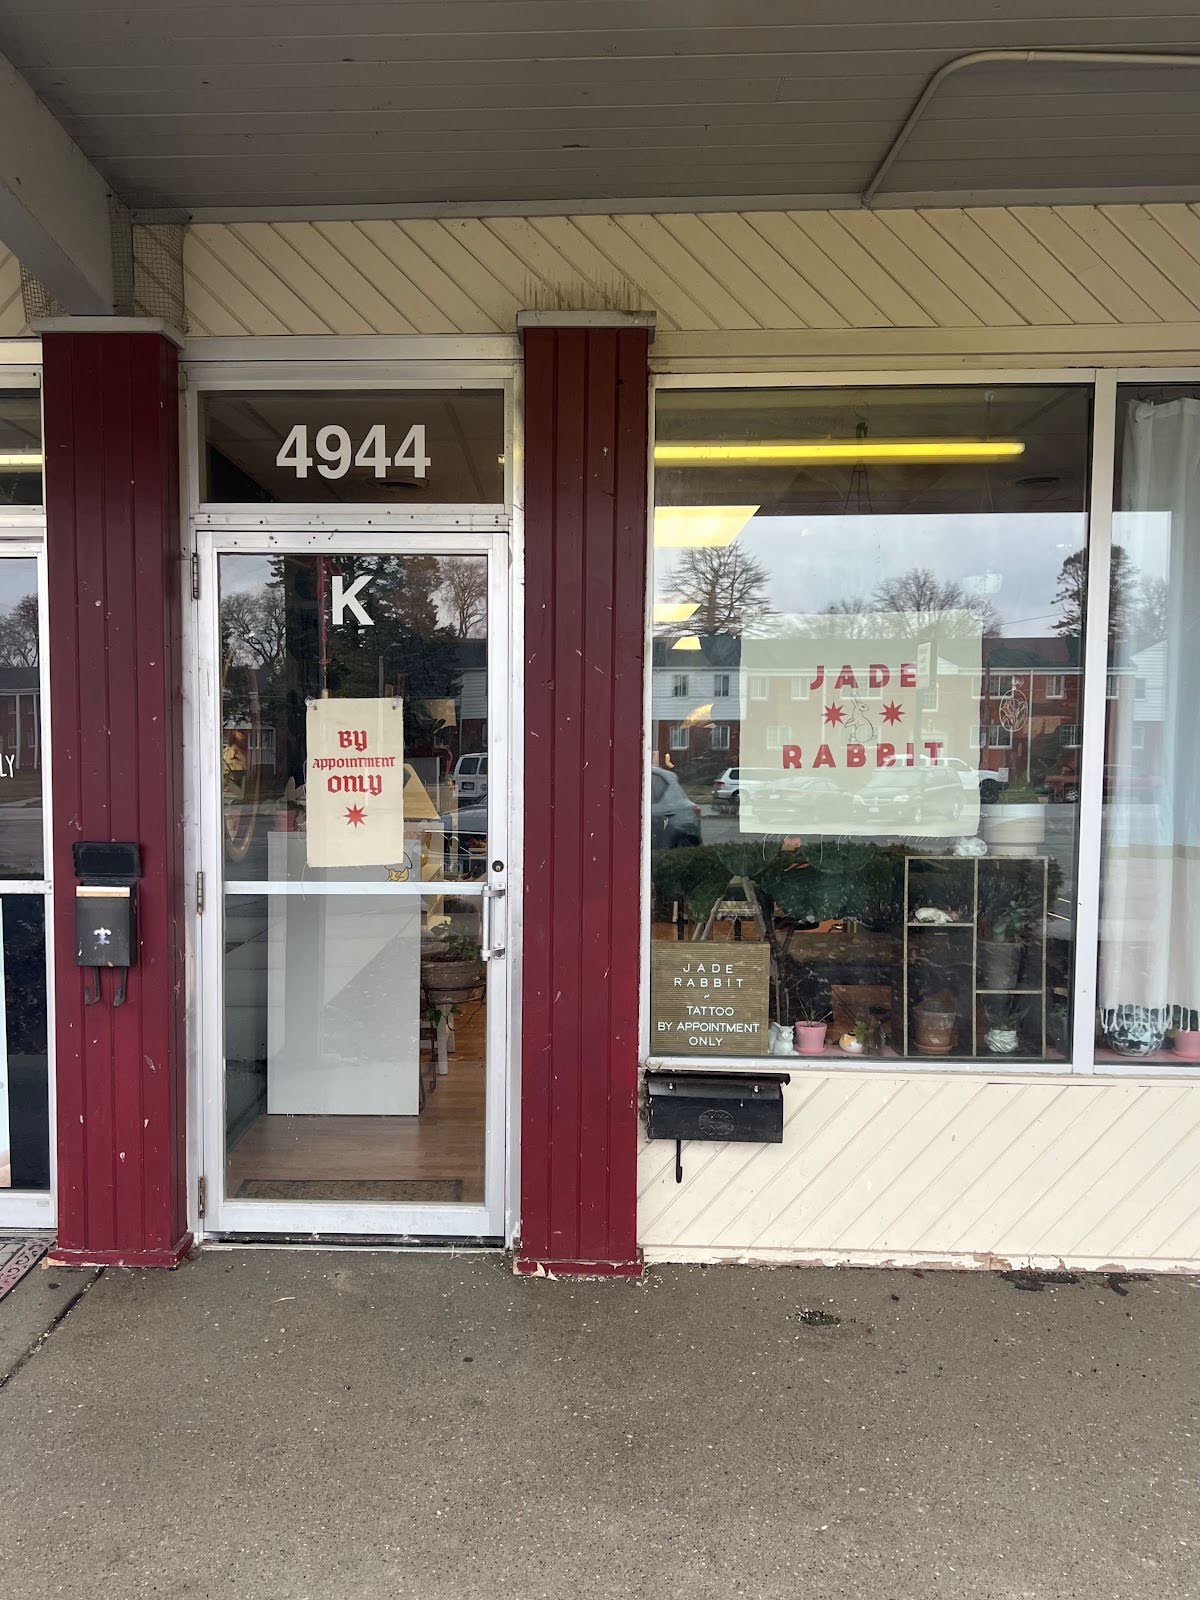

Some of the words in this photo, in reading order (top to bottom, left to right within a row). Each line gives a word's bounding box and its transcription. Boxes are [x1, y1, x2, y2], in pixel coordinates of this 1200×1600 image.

[276, 424, 431, 479] 4944
[331, 575, 375, 625] K
[809, 663, 917, 690] JADE
[337, 730, 368, 752] BY
[782, 742, 944, 769] RABBIT
[683, 963, 734, 974] JADE
[674, 977, 744, 988] RABBIT
[686, 1006, 735, 1017] TATTOO
[657, 1021, 673, 1031] BY
[676, 1022, 760, 1033] APPOINTMENT
[688, 1036, 723, 1047] ONLY
